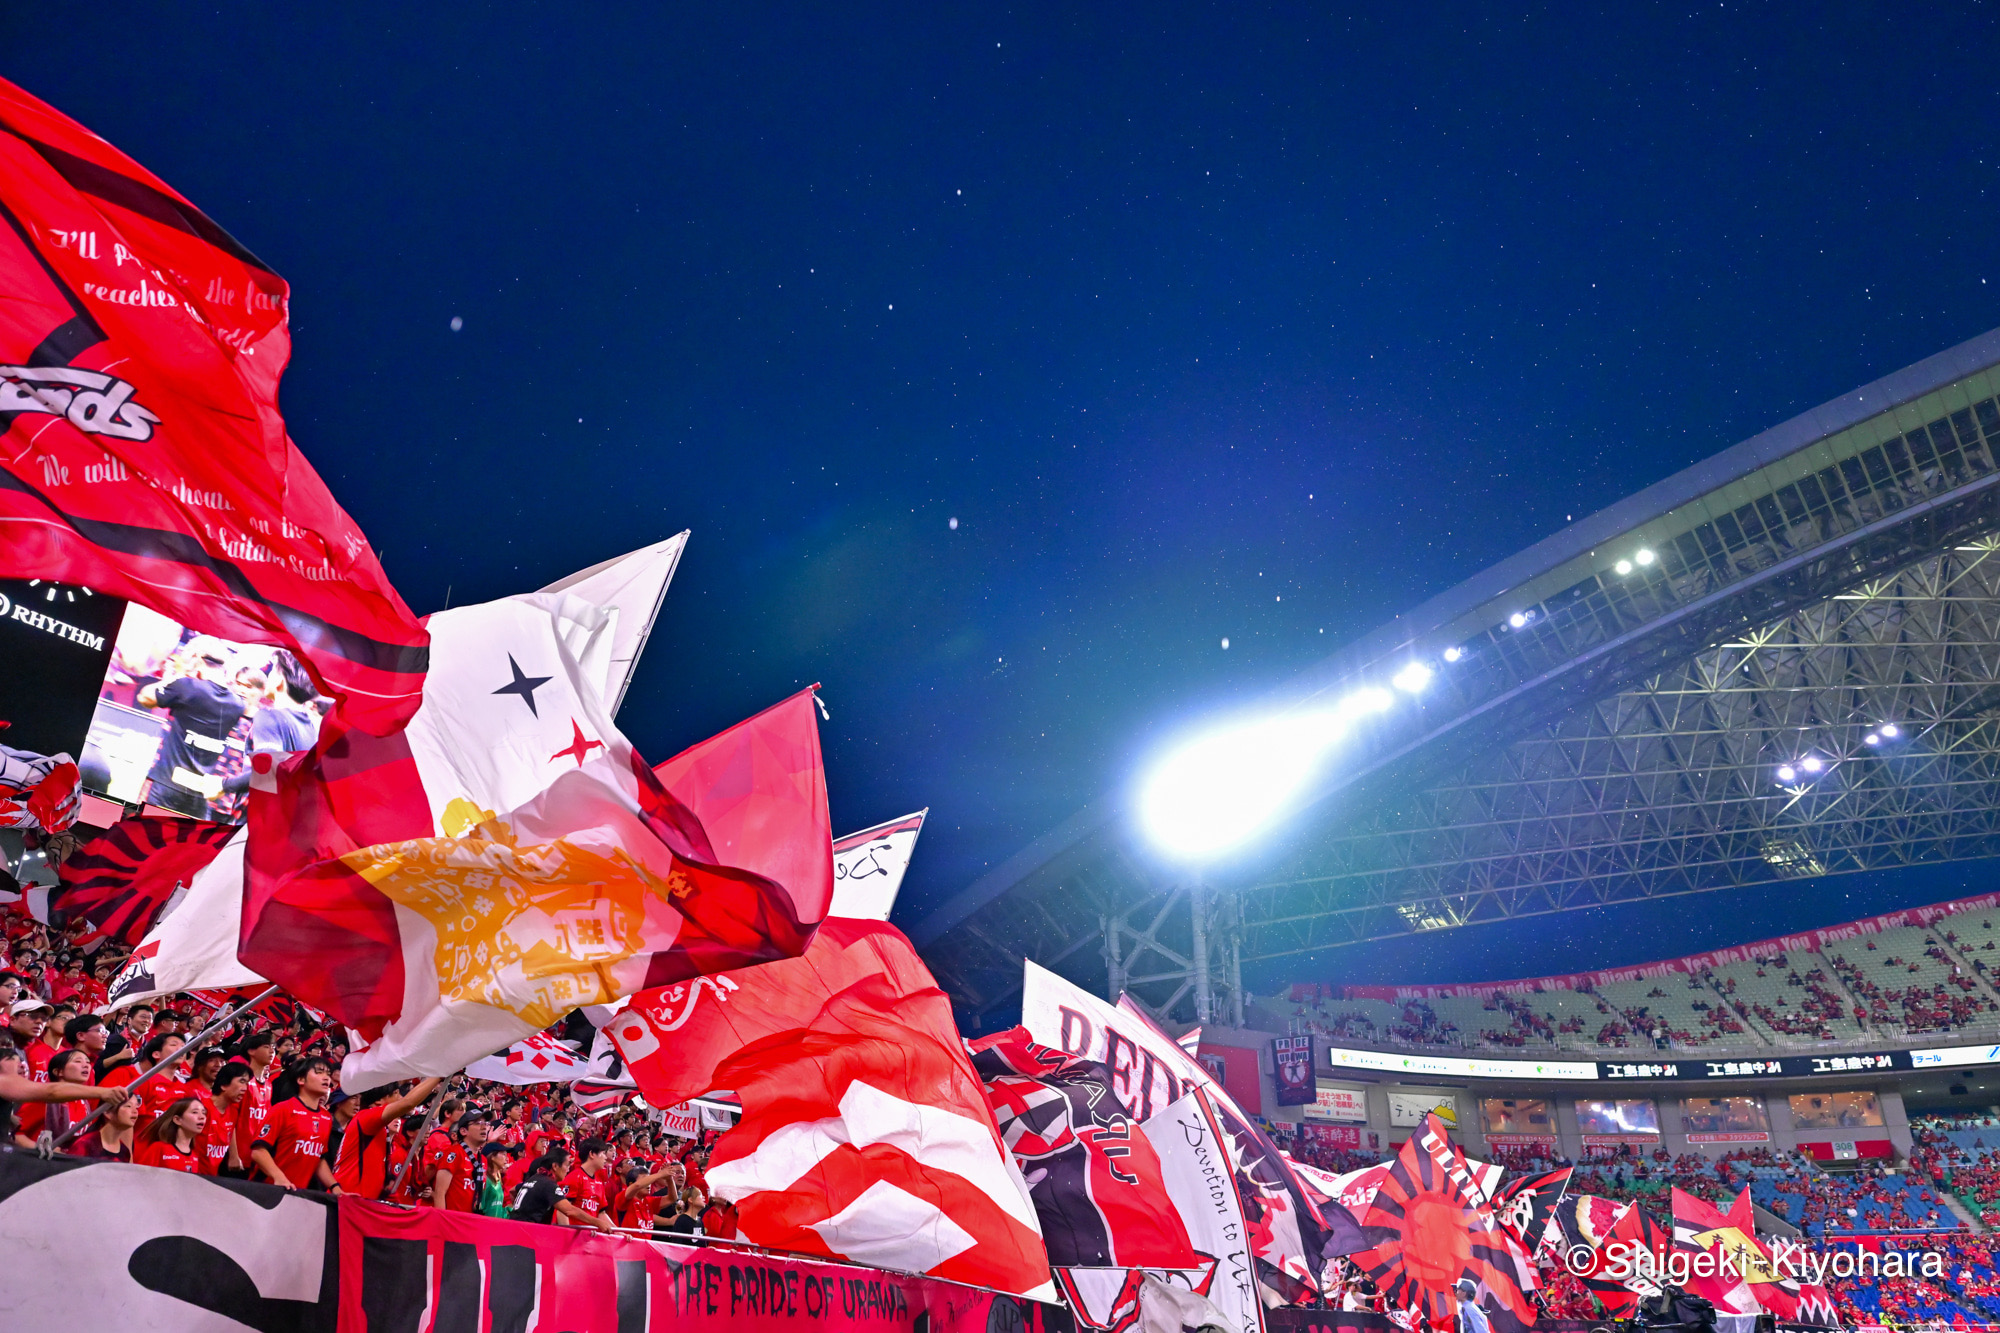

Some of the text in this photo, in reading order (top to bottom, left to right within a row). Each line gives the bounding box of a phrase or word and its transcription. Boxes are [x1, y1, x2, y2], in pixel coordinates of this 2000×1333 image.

[49, 229, 101, 260] I'll
[205, 277, 235, 306] the
[84, 279, 179, 308] reaches
[36, 454, 72, 487] We
[84, 453, 130, 484] will
[11, 604, 105, 652] RHYTHM
[1396, 988, 1422, 999] We
[1457, 981, 1534, 998] Diamonds
[1539, 978, 1566, 991] We
[1682, 955, 1710, 975] Yes
[1712, 947, 1741, 967] We
[1741, 940, 1779, 962] Love
[1780, 934, 1810, 956] You
[1816, 923, 1858, 947] Boys
[1860, 920, 1875, 937] In
[1177, 1112, 1229, 1215] Devotion
[1222, 1222, 1238, 1241] to
[1834, 1141, 1853, 1151] 308
[1420, 1130, 1495, 1234] ULTRA
[663, 1256, 722, 1318] THE
[728, 1264, 800, 1318] PRIDE
[804, 1274, 835, 1322] OF
[838, 1276, 908, 1324] URAWA
